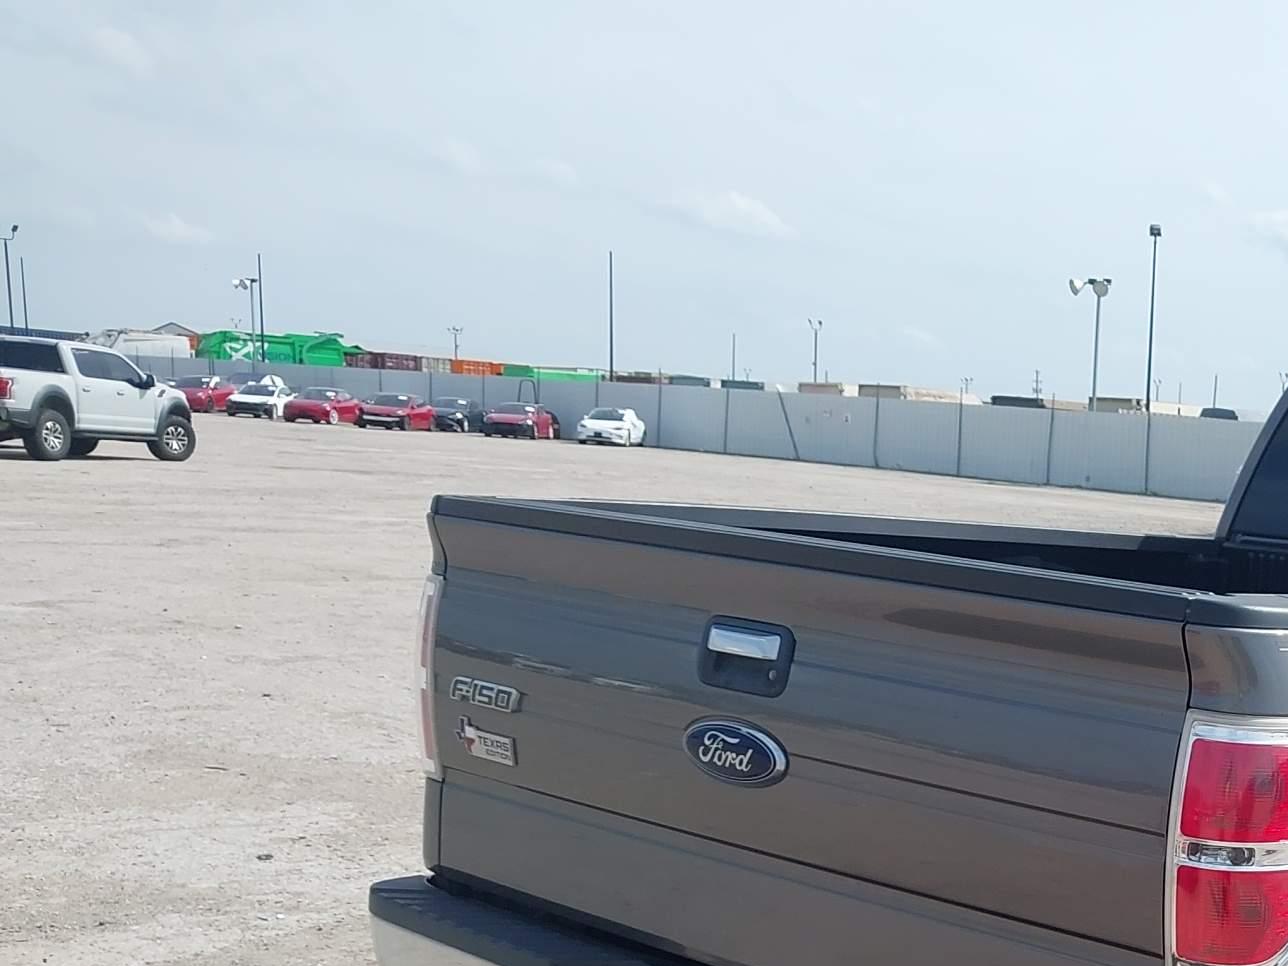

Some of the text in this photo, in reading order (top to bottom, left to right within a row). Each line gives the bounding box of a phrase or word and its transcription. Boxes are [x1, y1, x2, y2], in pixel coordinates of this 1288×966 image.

[450, 676, 520, 712] F-150
[477, 735, 510, 752] TEXAS
[699, 731, 753, 771] Ford
